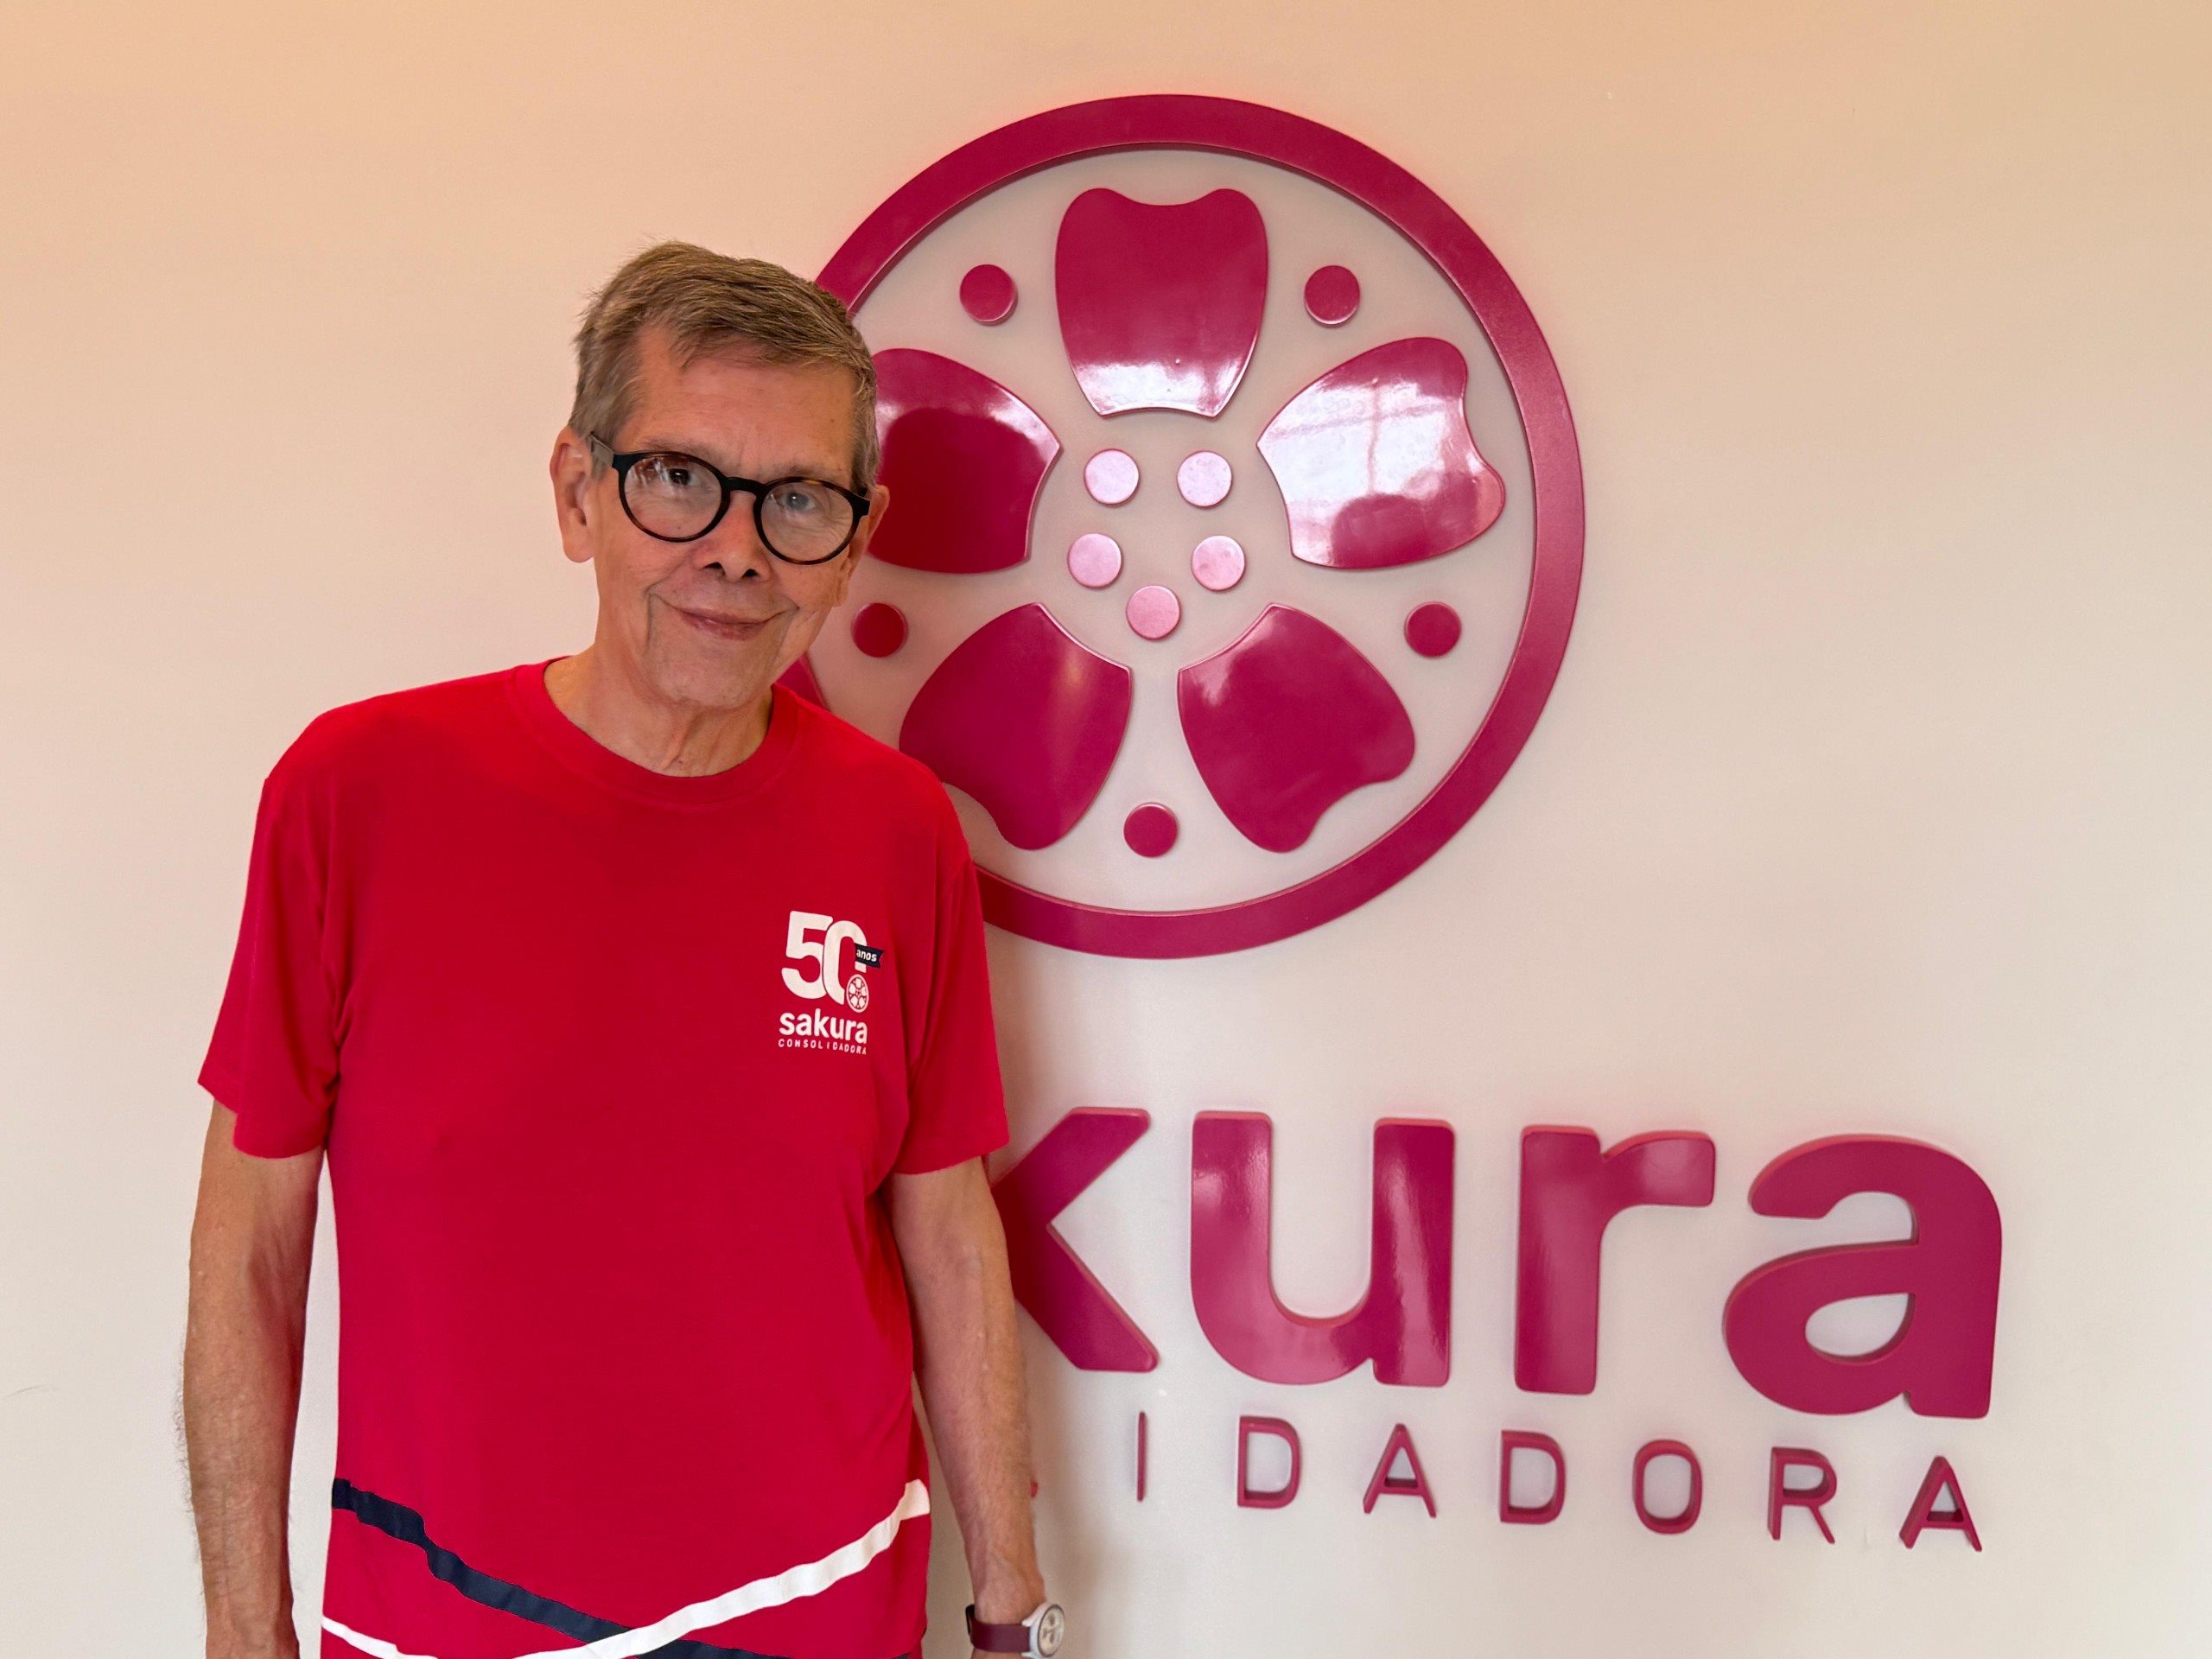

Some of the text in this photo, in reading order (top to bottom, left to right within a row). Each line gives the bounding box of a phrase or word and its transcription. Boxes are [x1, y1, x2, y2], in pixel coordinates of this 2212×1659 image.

[781, 910, 868, 1006] 50
[855, 948, 878, 963] anos
[779, 1007, 868, 1045] sakura
[778, 1038, 868, 1056] CONSOLIDADORA
[1029, 1412, 1983, 1553] IDADORA
